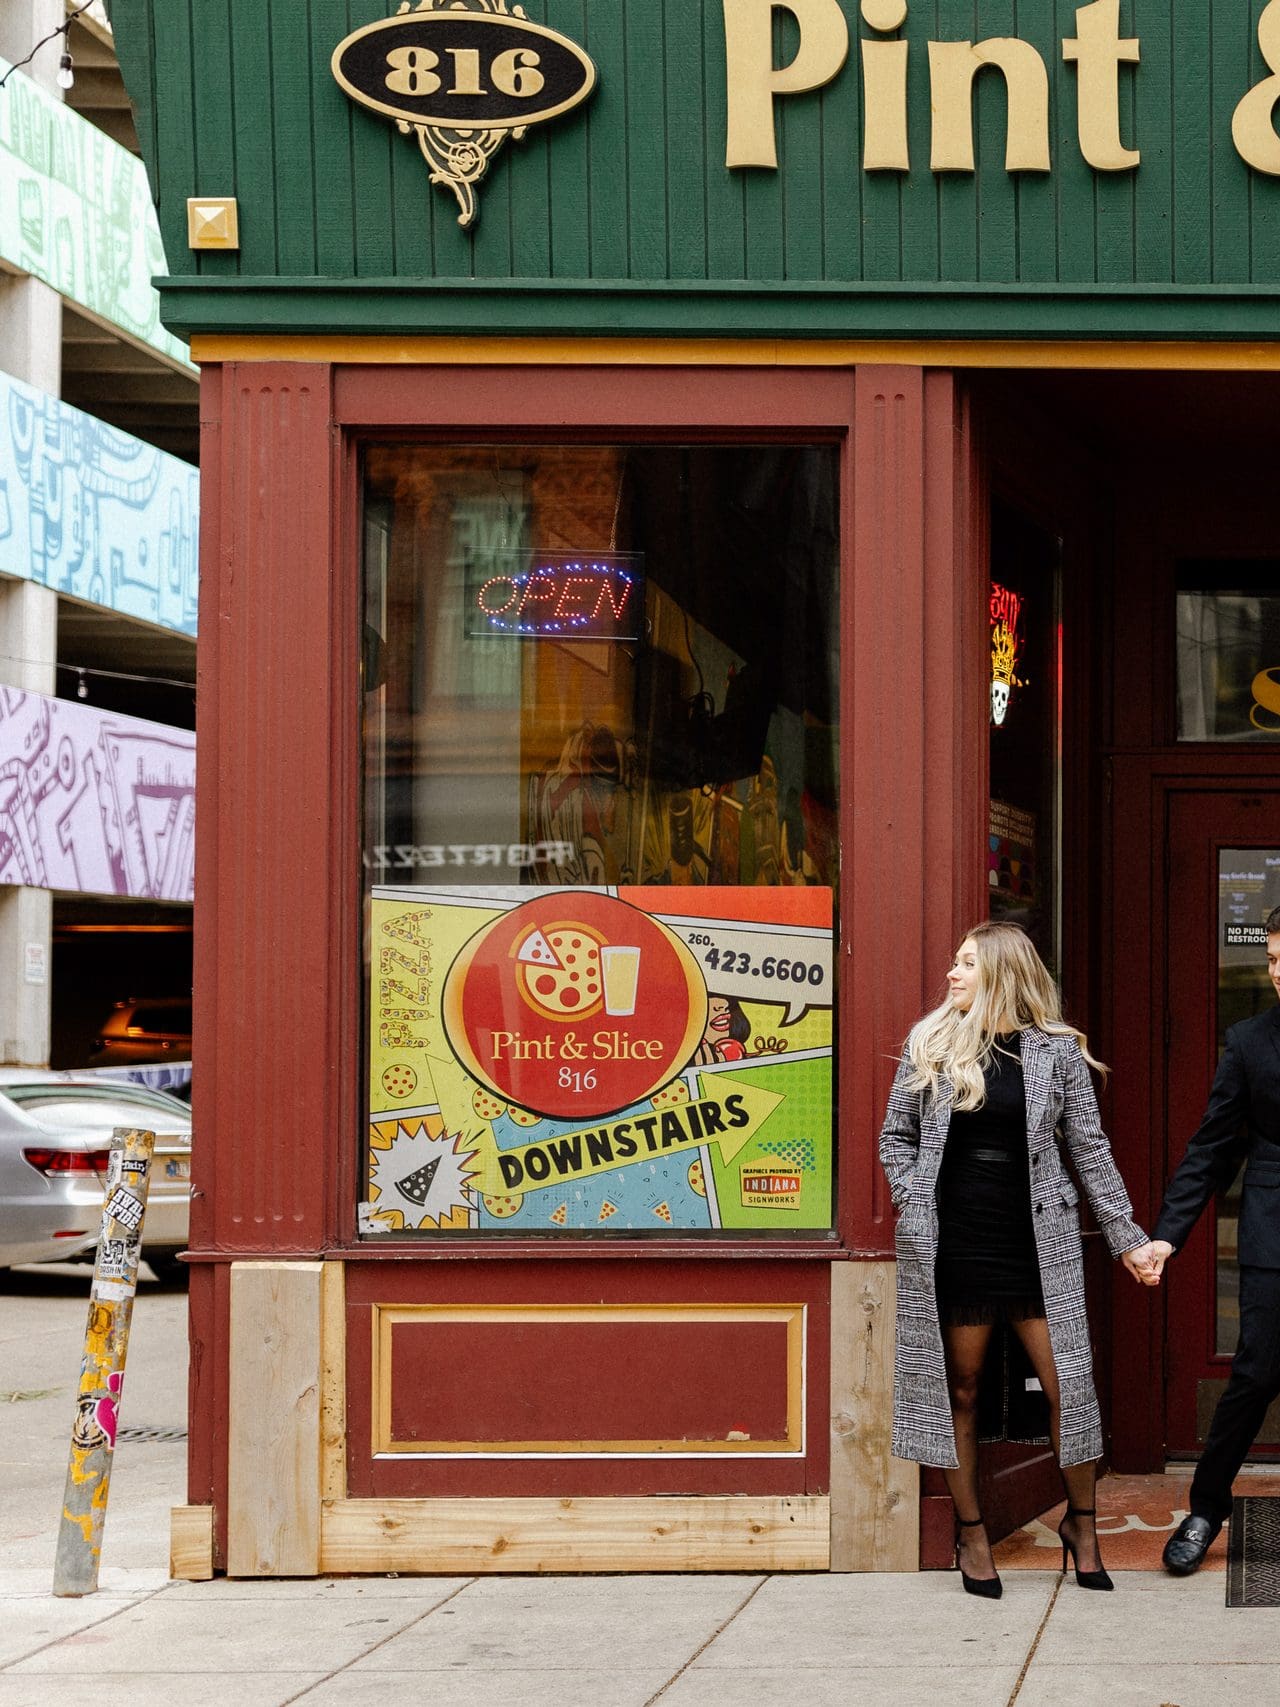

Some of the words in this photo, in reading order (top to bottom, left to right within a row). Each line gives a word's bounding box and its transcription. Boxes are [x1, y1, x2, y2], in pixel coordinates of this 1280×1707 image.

[385, 46, 545, 97] 816
[724, 0, 1140, 171] Pint
[477, 575, 632, 619] OPEN
[688, 932, 715, 947] 260.
[1228, 927, 1242, 935] NO
[1243, 927, 1269, 935] PUBL
[1228, 935, 1269, 943] RESTROO
[379, 909, 432, 1049] PIZZA
[704, 947, 824, 986] 423.6600
[491, 1031, 555, 1060] Pint
[560, 1032, 588, 1060] &
[592, 1030, 663, 1060] Slice
[557, 1067, 597, 1092] 816
[498, 1094, 750, 1188] DOWNSTAIRS
[746, 1178, 797, 1191] INDIANA
